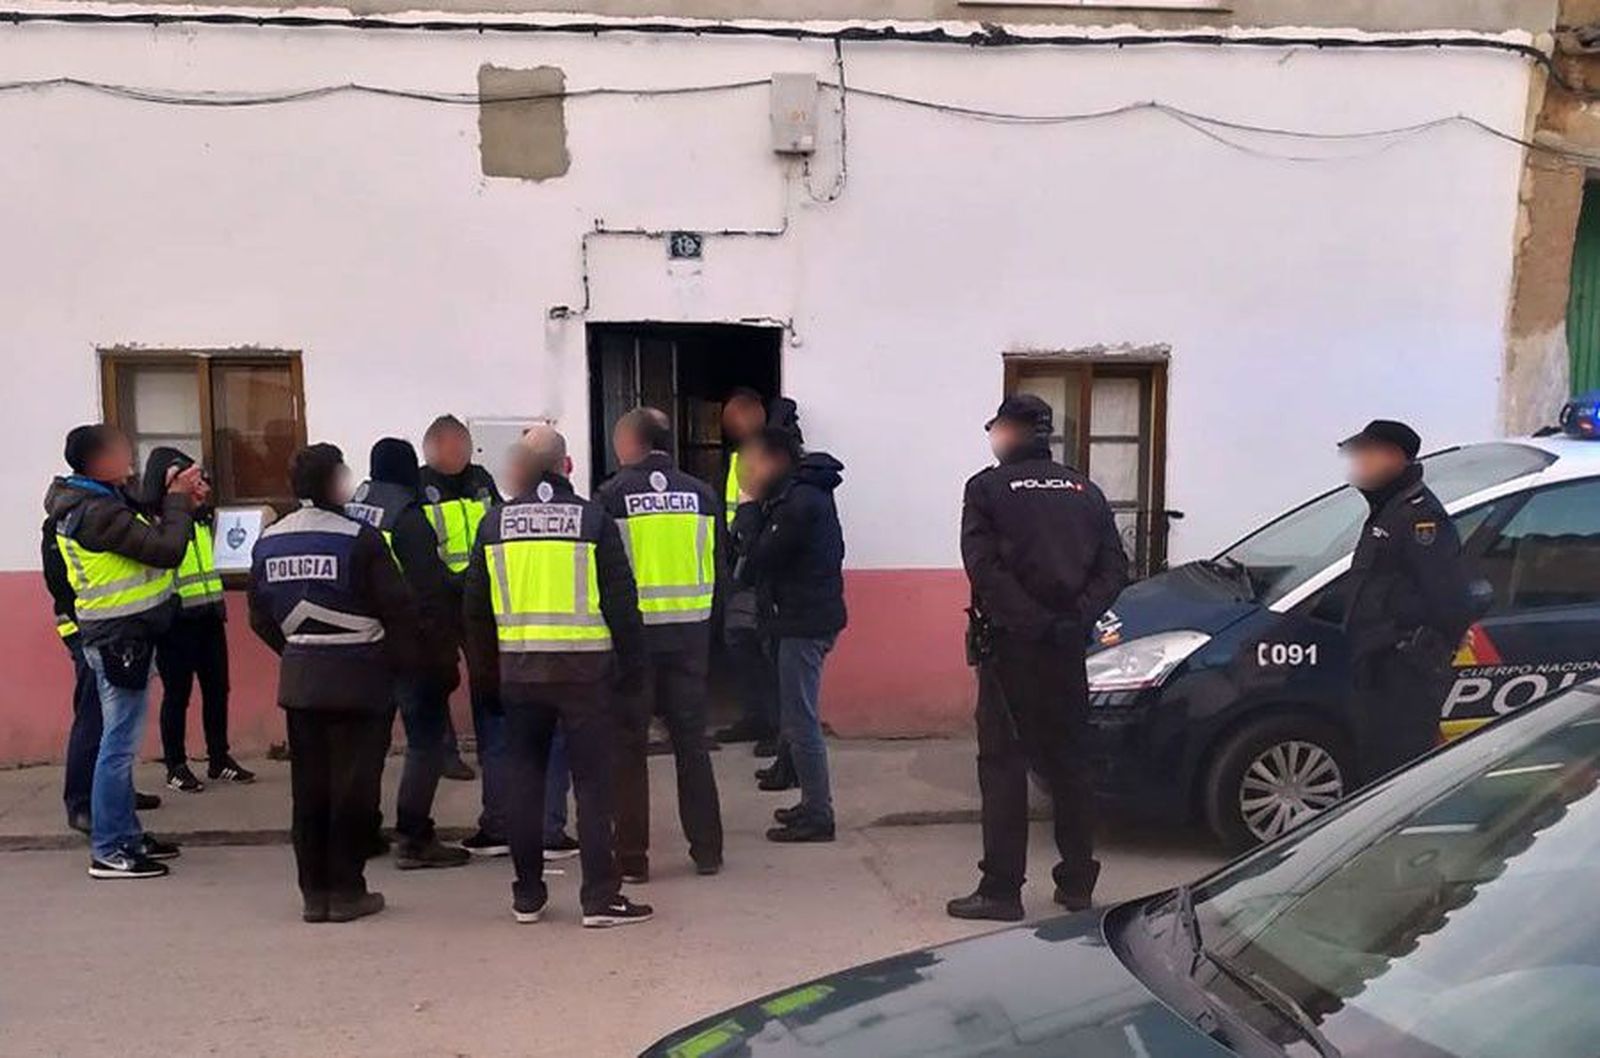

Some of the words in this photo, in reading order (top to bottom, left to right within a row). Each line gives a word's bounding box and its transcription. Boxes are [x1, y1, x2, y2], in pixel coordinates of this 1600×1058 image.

[627, 494, 697, 513] POLICIA
[504, 517, 577, 536] POLICIA
[268, 557, 334, 579] POLICIA
[1271, 642, 1317, 666] 091
[1457, 665, 1533, 678] CUERPO
